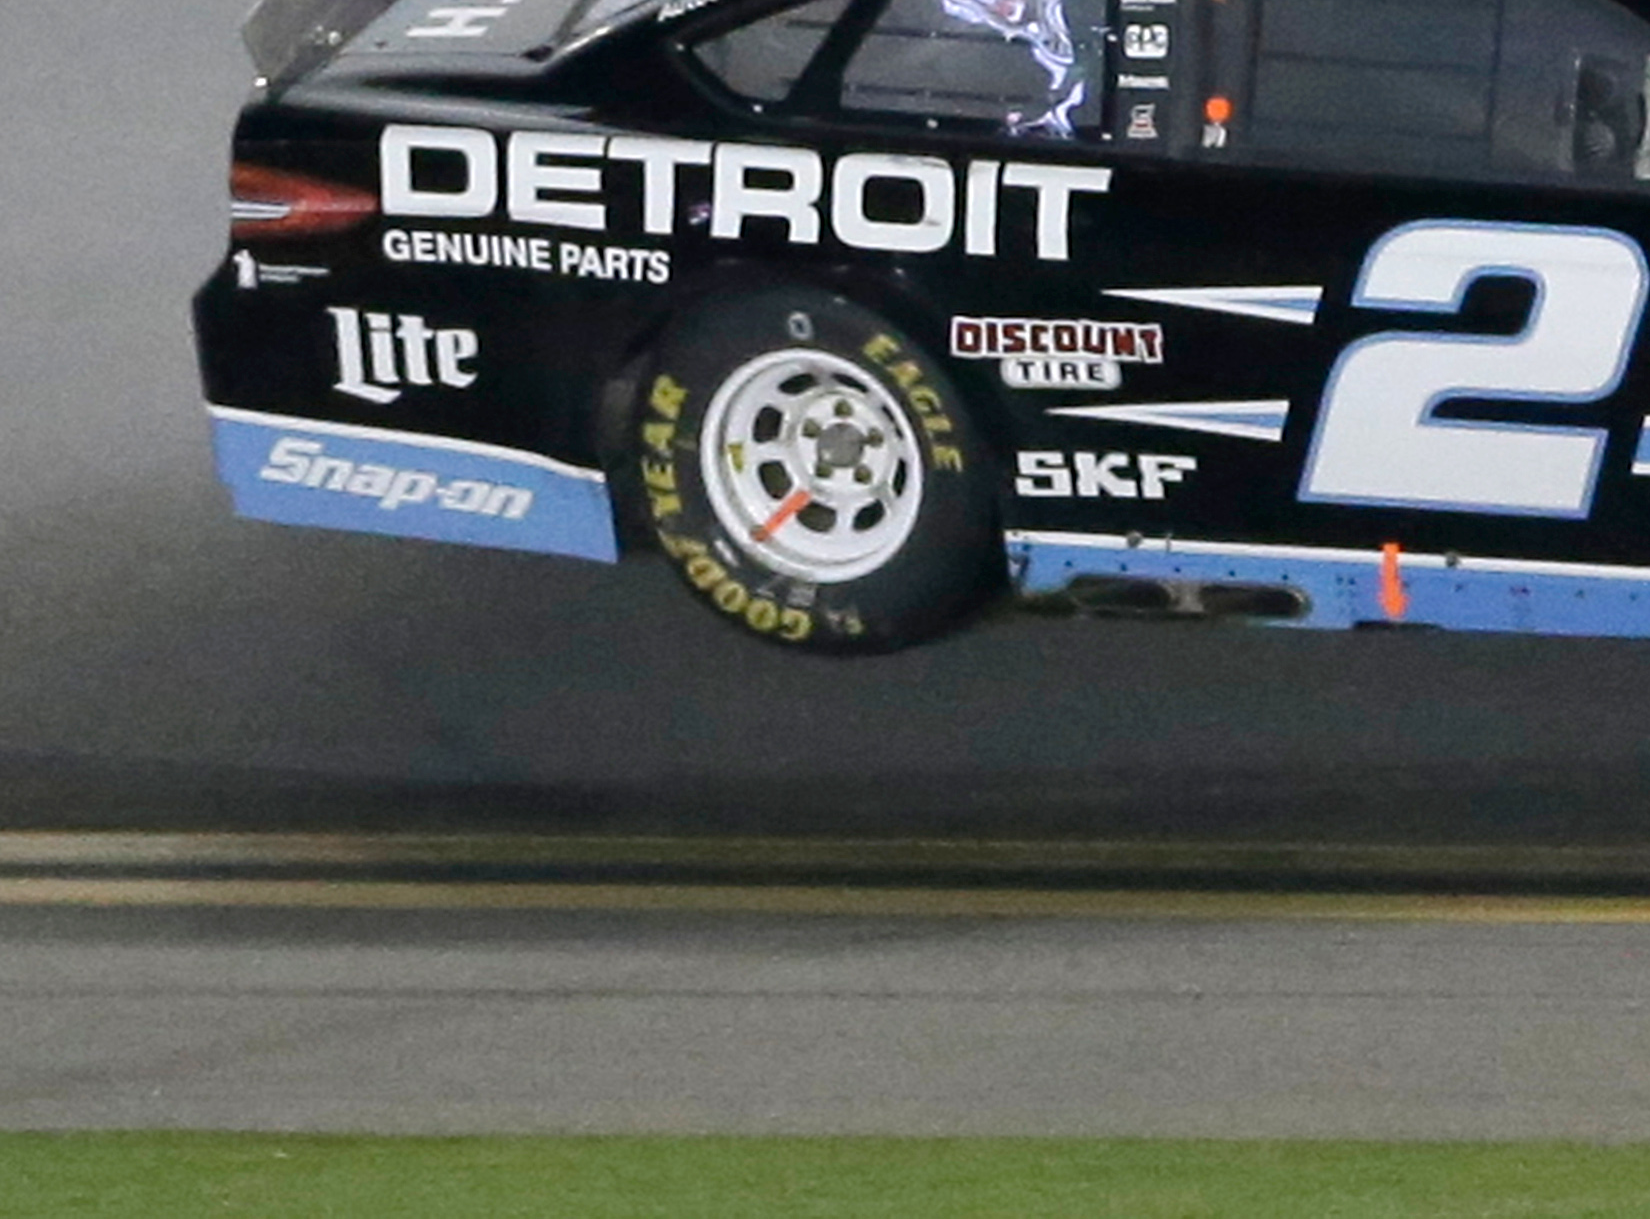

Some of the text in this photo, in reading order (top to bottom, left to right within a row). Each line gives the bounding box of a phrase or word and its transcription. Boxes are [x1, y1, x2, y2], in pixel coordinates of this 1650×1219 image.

[379, 124, 1113, 262] DETROIT
[383, 230, 670, 282] GENUINE PARTS
[326, 306, 479, 404] Lite
[951, 316, 1163, 363] DISCOUNT
[1016, 361, 1105, 385] TIRE
[258, 436, 534, 520] Snap-on
[1015, 450, 1197, 500] SKF
